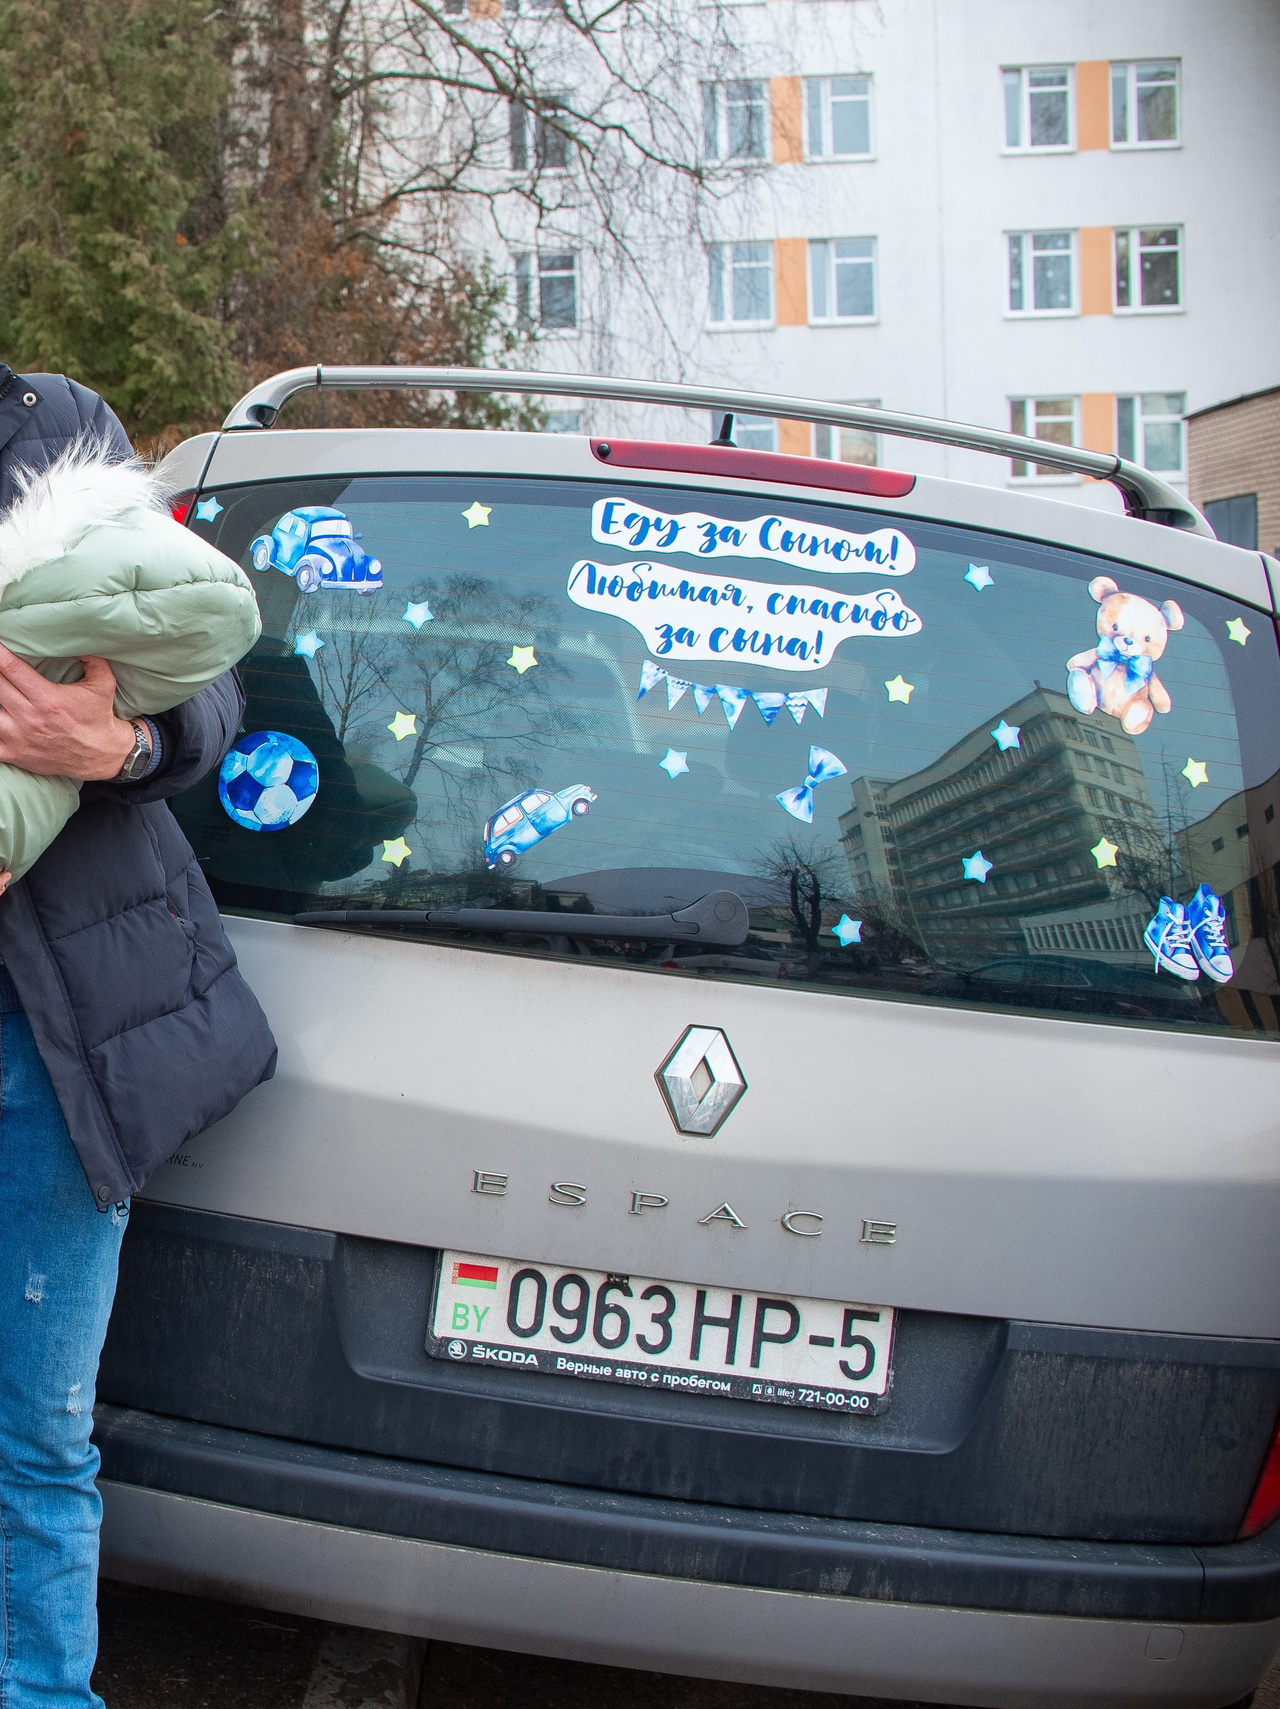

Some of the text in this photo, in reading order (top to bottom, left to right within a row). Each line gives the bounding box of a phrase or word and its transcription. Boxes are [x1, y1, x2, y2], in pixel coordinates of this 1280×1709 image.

[600, 502, 899, 570] Еду за Сыном!
[569, 562, 916, 632] Любимая, спасибо
[654, 623, 823, 664] за сына!
[471, 1169, 898, 1244] ESPACE
[451, 1302, 490, 1333] BY
[506, 1268, 882, 1381] 0963 HP-5
[472, 1345, 539, 1366] ŠKODA
[556, 1357, 731, 1392] Верные авто с пробегом
[798, 1389, 870, 1409] 721-00-00
